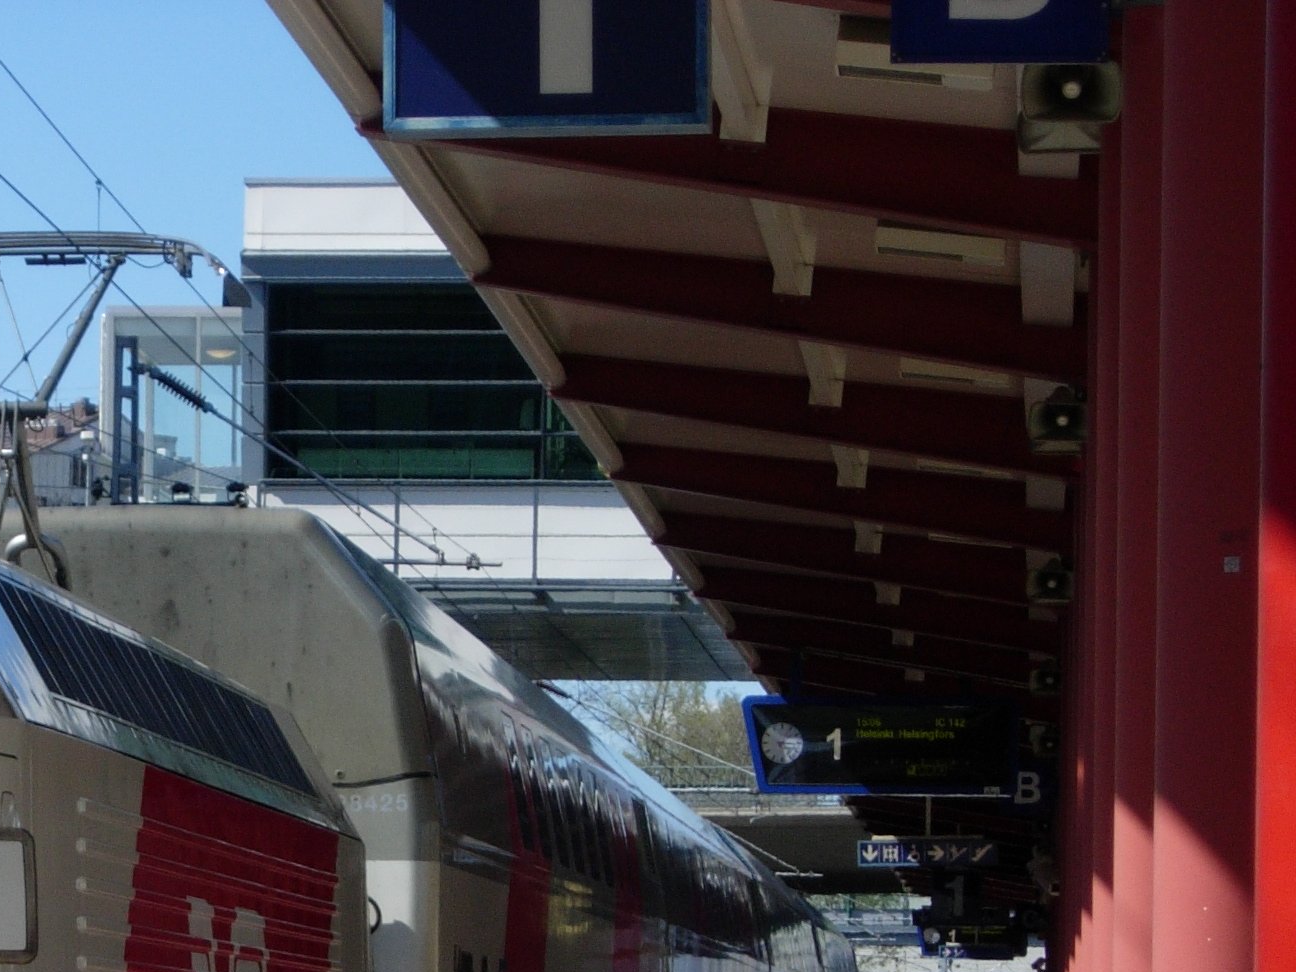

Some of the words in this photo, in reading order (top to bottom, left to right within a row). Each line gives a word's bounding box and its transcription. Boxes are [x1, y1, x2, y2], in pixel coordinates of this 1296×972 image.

[855, 728, 894, 739] Helsinki
[898, 728, 955, 741] Helsingfors
[935, 718, 946, 727] IC
[826, 727, 842, 761] 1
[1014, 771, 1040, 804] B
[944, 874, 965, 917] 1
